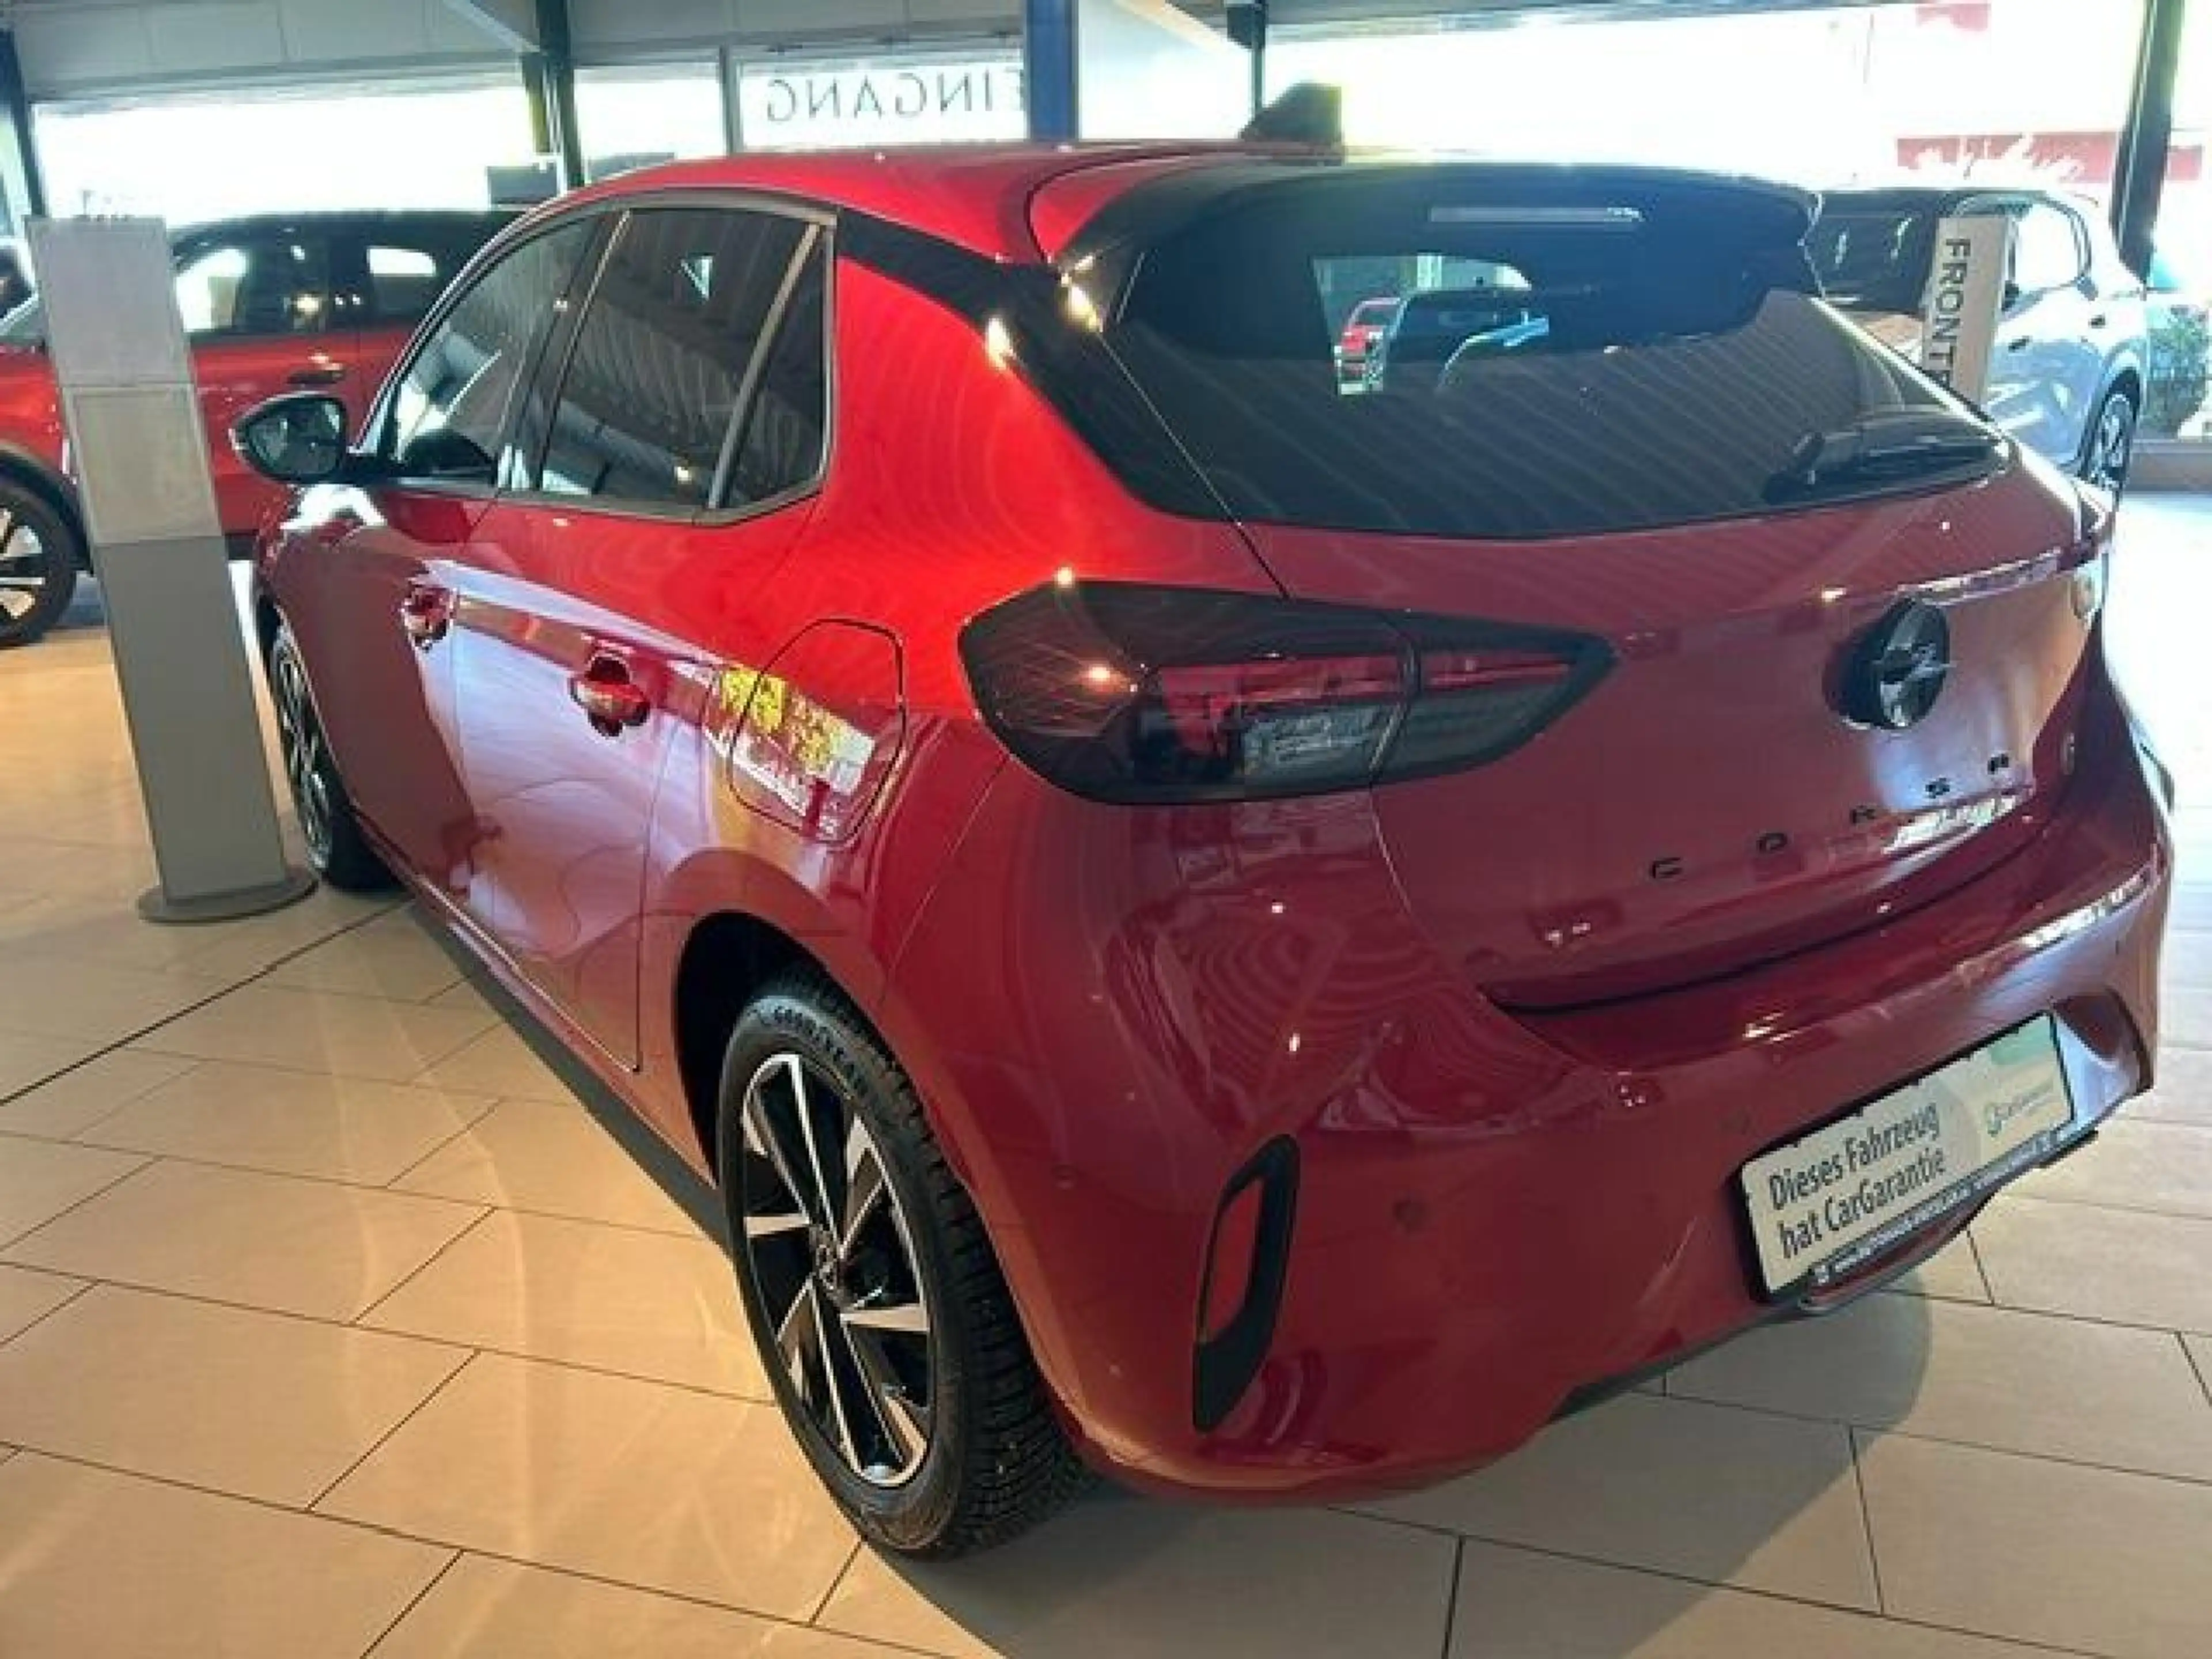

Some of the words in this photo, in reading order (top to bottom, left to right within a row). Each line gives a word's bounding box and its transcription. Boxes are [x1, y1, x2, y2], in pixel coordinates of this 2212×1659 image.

[1769, 1152, 1843, 1209] Dieses
[1846, 1103, 1941, 1172] Fahrzeug
[1779, 1210, 1822, 1259] hat
[1824, 1147, 1945, 1232] CarGarantie
